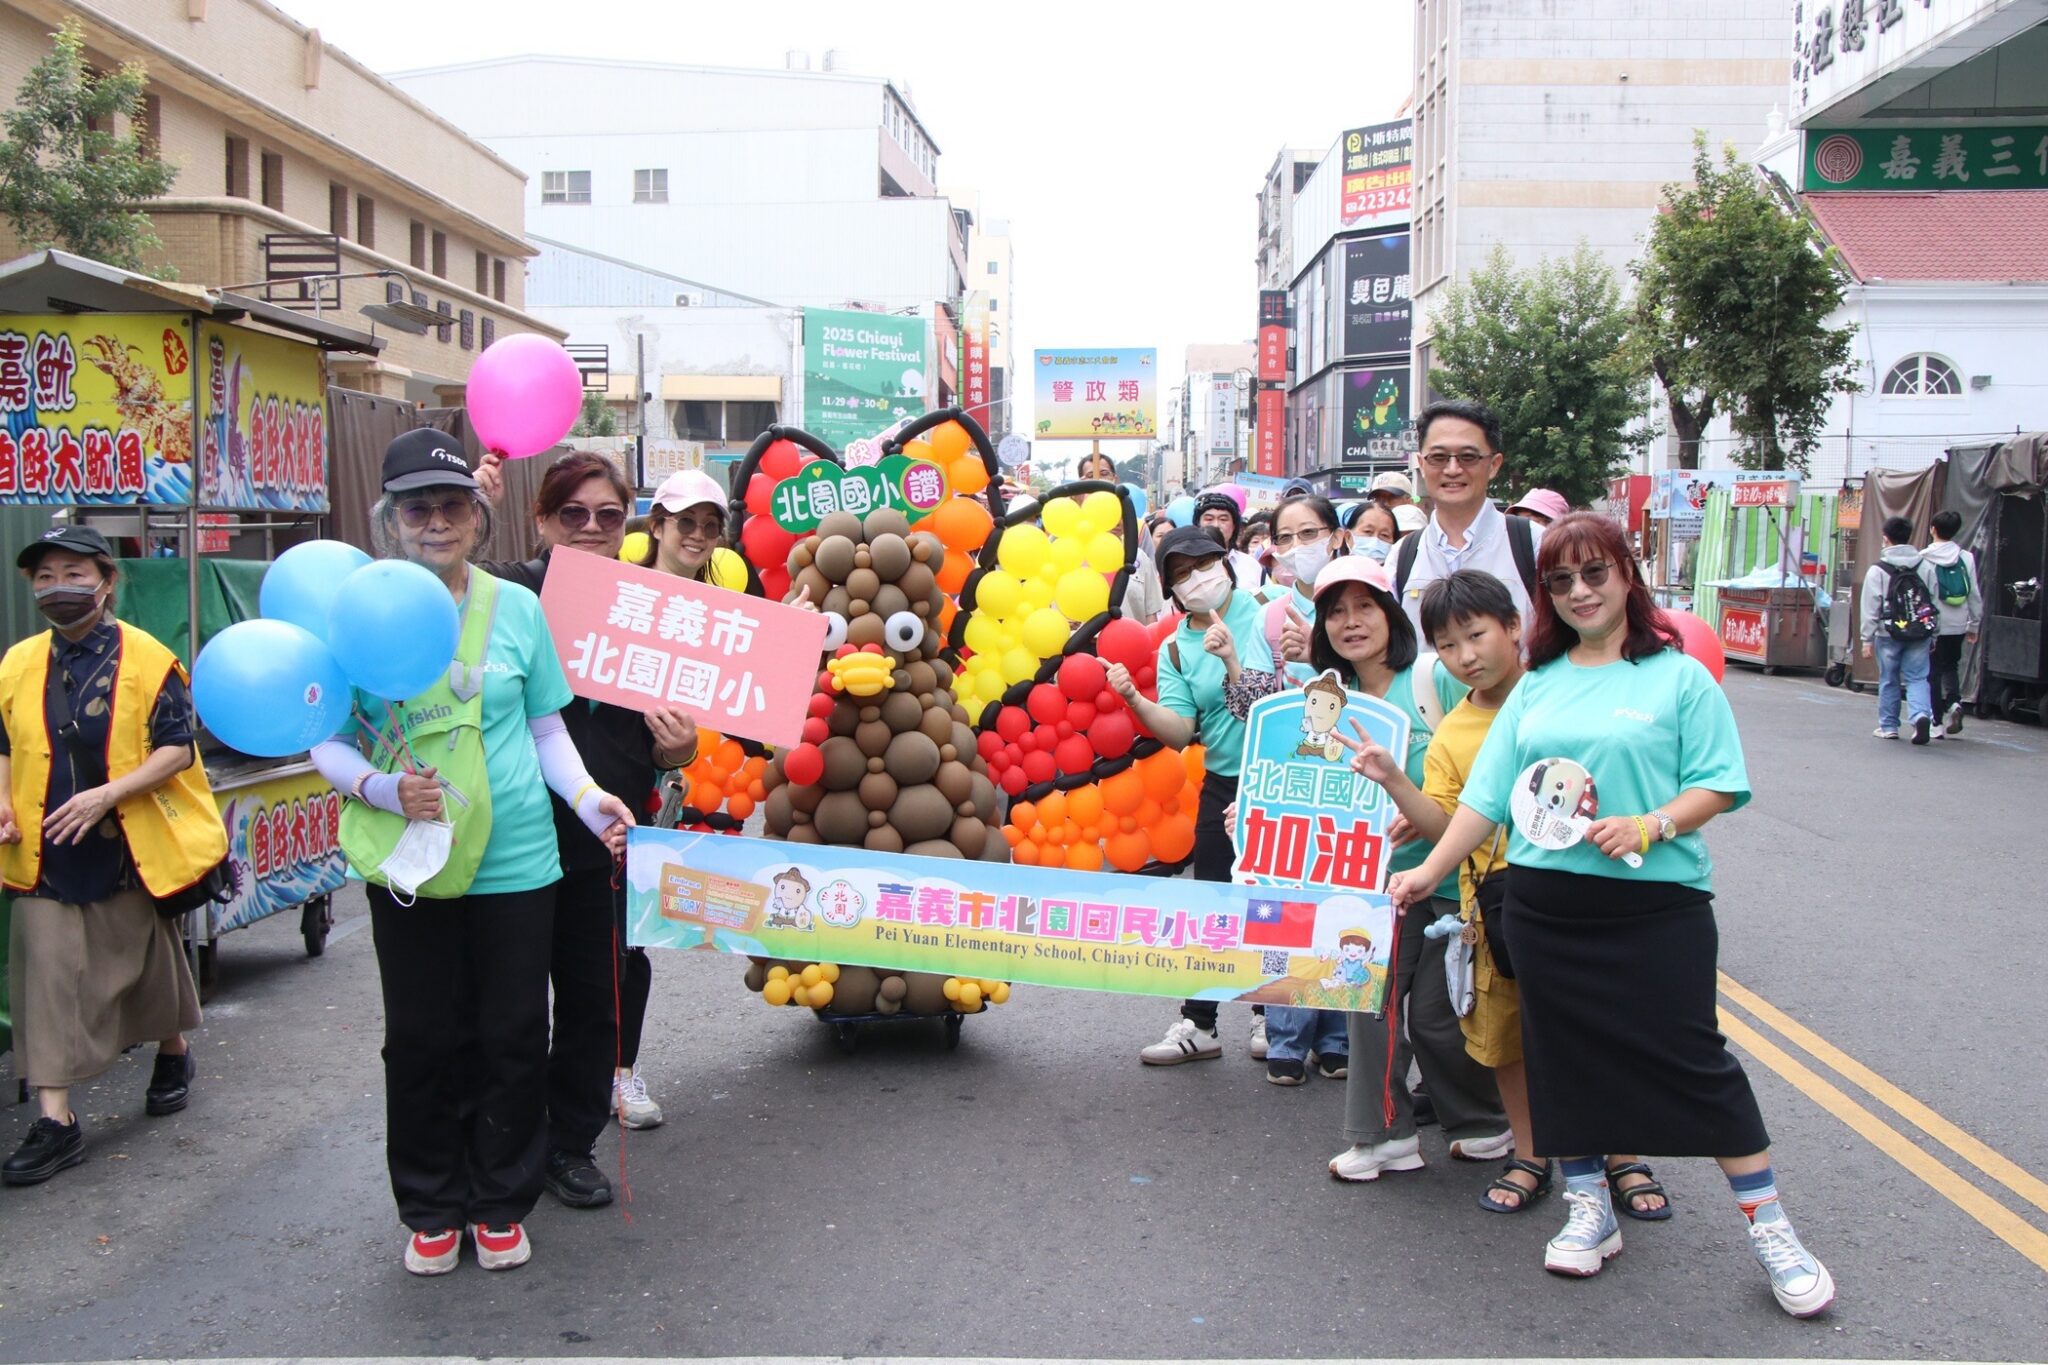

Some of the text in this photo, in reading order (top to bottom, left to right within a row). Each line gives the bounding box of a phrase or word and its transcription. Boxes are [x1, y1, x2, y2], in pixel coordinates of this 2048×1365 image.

[1350, 274, 1411, 305] 變色龍
[822, 326, 904, 349] 2025 Chiayi
[822, 343, 922, 363] Flower Festival
[821, 396, 846, 407] 11/29
[1052, 379, 1140, 403] 警政類
[251, 396, 326, 494] 香酥大魷魚
[777, 472, 901, 523] 北園國小
[607, 580, 760, 657] 嘉義市
[567, 632, 766, 718] 北園國小
[1244, 760, 1394, 813] 北園國小
[253, 790, 341, 880] 香酥大魷魚
[1238, 808, 1384, 889] 加油
[663, 895, 702, 914] VICTORY
[677, 886, 691, 896] the
[874, 882, 1243, 953] 嘉義市北園國民小學
[875, 925, 1236, 975] Pei Yuan Elementary School, Chiayi City, Taiwan
